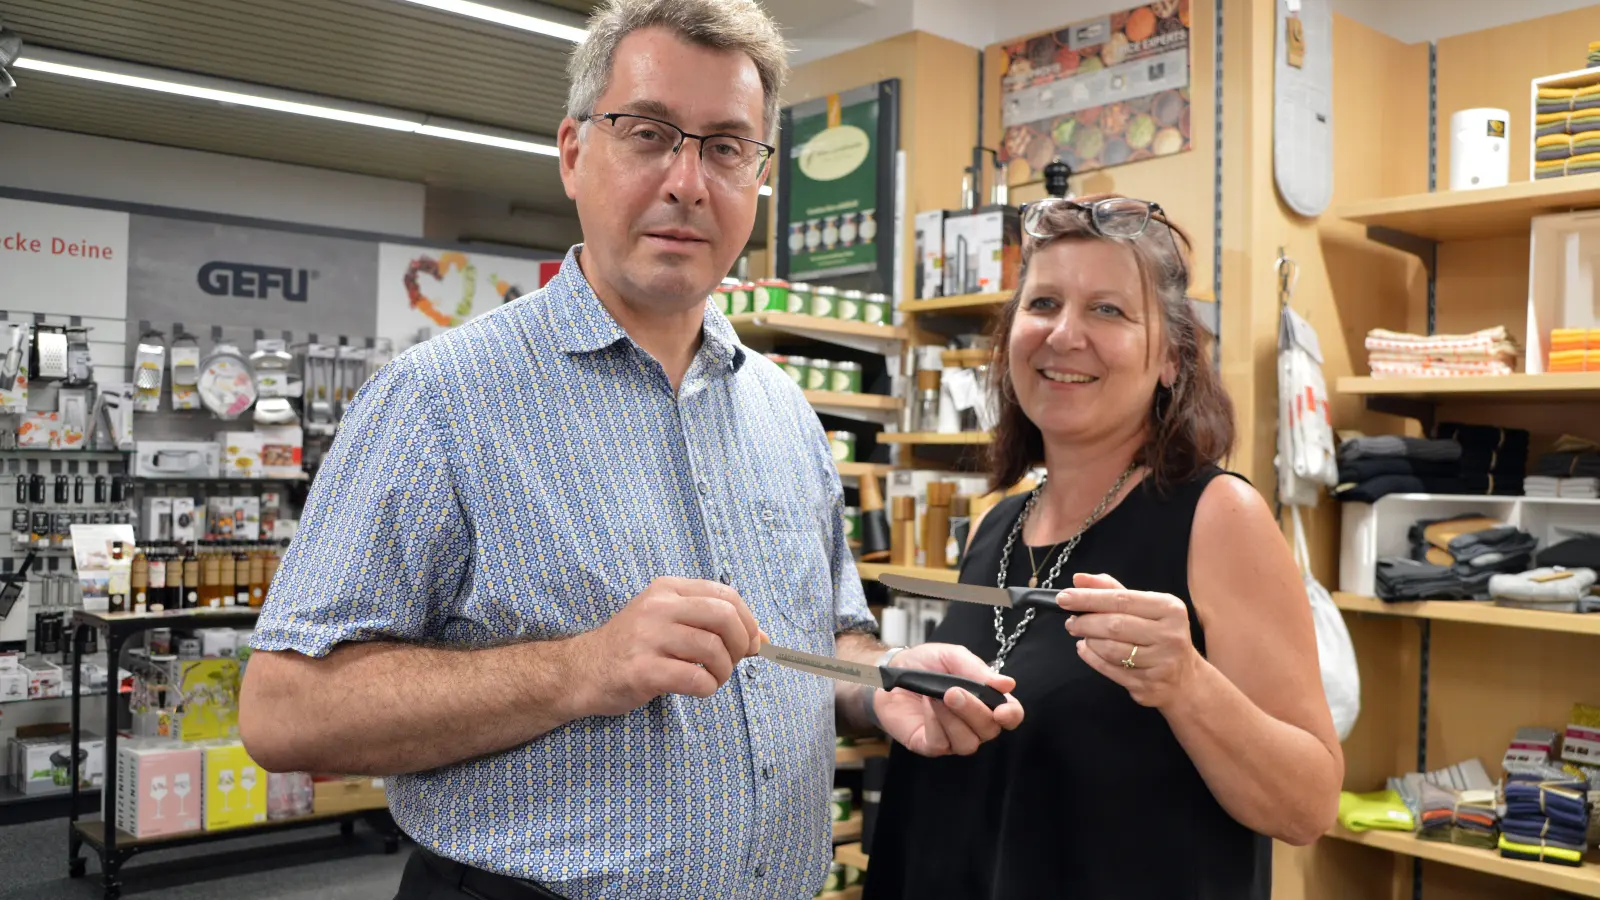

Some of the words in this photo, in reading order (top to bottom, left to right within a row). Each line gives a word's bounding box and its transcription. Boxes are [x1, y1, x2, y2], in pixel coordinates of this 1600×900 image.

[0, 231, 41, 253] cke
[51, 236, 113, 260] Deine
[197, 260, 308, 303] GEFU
